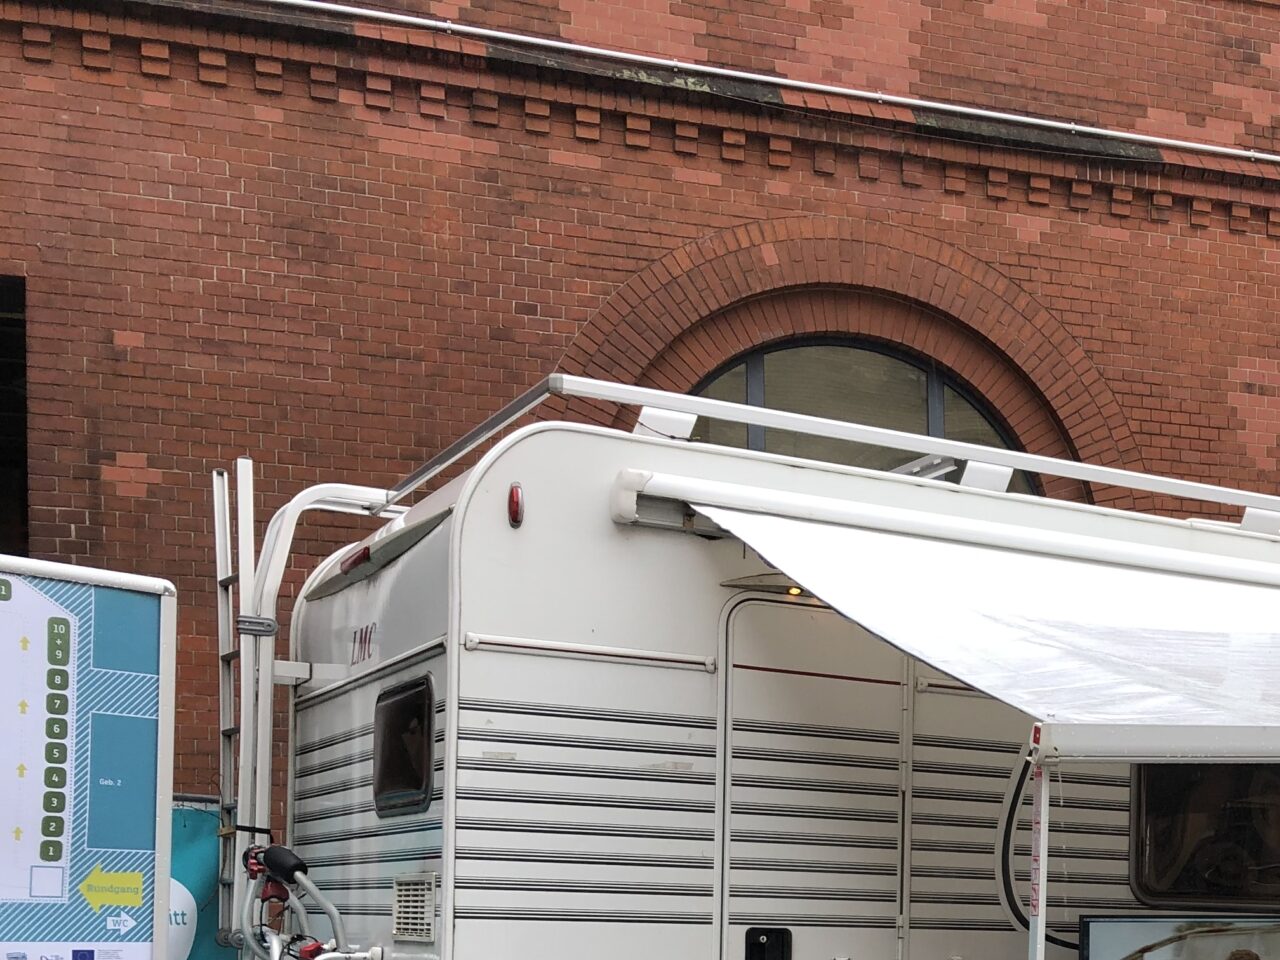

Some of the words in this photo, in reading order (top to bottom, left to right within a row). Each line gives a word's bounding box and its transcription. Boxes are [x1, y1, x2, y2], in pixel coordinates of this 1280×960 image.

[53, 624, 66, 634] 10
[350, 622, 377, 667] LMC
[55, 650, 63, 659] 9
[54, 675, 62, 684] 8
[54, 699, 61, 709] 7
[53, 724, 60, 734] 6
[52, 748, 60, 758] 5
[51, 773, 59, 783] 4
[99, 777, 114, 787] Geb.
[116, 779, 123, 787] 2
[50, 797, 58, 807] 3
[49, 822, 57, 832] 2
[48, 846, 55, 856] 1
[87, 883, 139, 896] Rundgang
[111, 918, 129, 928] WC
